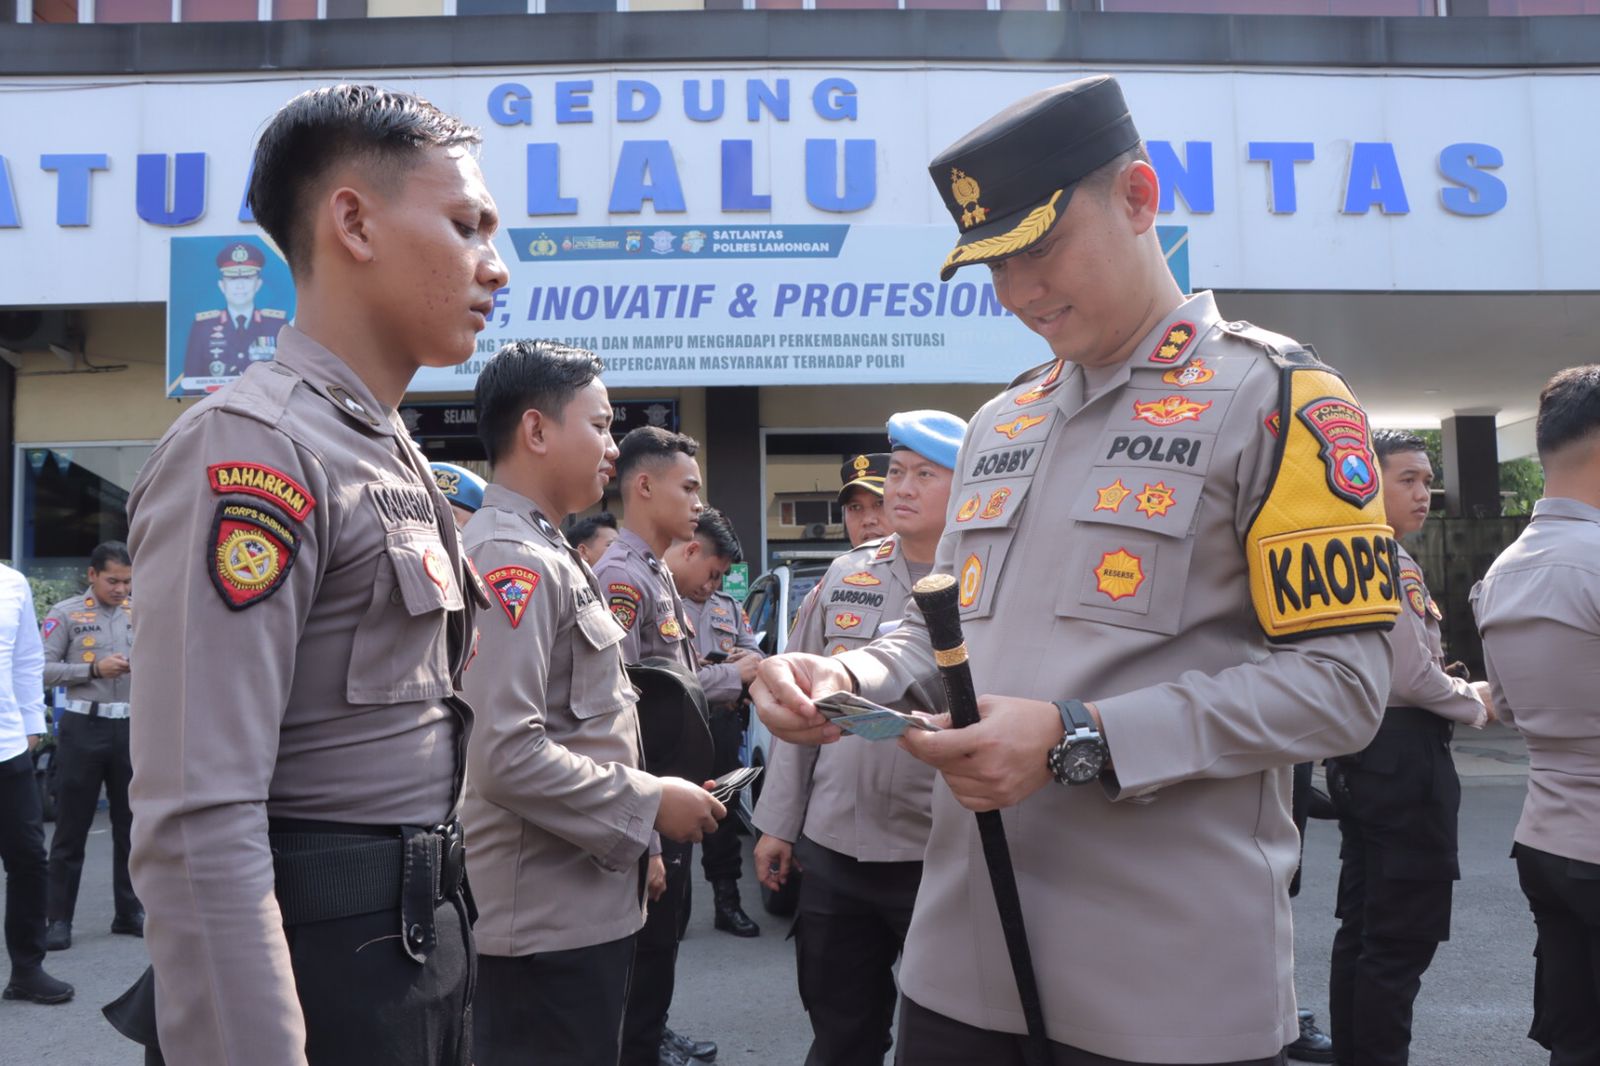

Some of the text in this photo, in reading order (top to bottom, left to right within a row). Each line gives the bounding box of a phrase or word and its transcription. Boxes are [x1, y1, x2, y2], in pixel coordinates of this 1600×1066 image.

[487, 77, 858, 127] GEDUNG
[0, 138, 1508, 229] TU LALU NTAS
[712, 230, 784, 241] SATLANTAS
[712, 241, 829, 253] POLRES LAMONGAN
[527, 284, 716, 321] INOVATIF
[728, 283, 757, 318] &
[773, 282, 1013, 318] PROFESION
[602, 336, 630, 350] DAN
[632, 335, 683, 349] MAMPU
[687, 334, 775, 349] MENGHADAPI
[779, 333, 887, 348] PERKEMBANGAN
[891, 333, 945, 347] SITUASI
[603, 357, 695, 371] KEPERCAYAAN
[700, 356, 792, 370] MASYARAKAT
[795, 355, 862, 369] TERHADAP
[866, 355, 905, 369] POLRI
[444, 409, 477, 424] SELAM
[1107, 435, 1201, 467] POLRI
[972, 448, 1035, 477] BOBBY
[218, 467, 305, 512] BAHARKAM
[224, 506, 257, 519] KORPS
[488, 568, 537, 582] OPS POLRI
[830, 589, 884, 607] DARSONO
